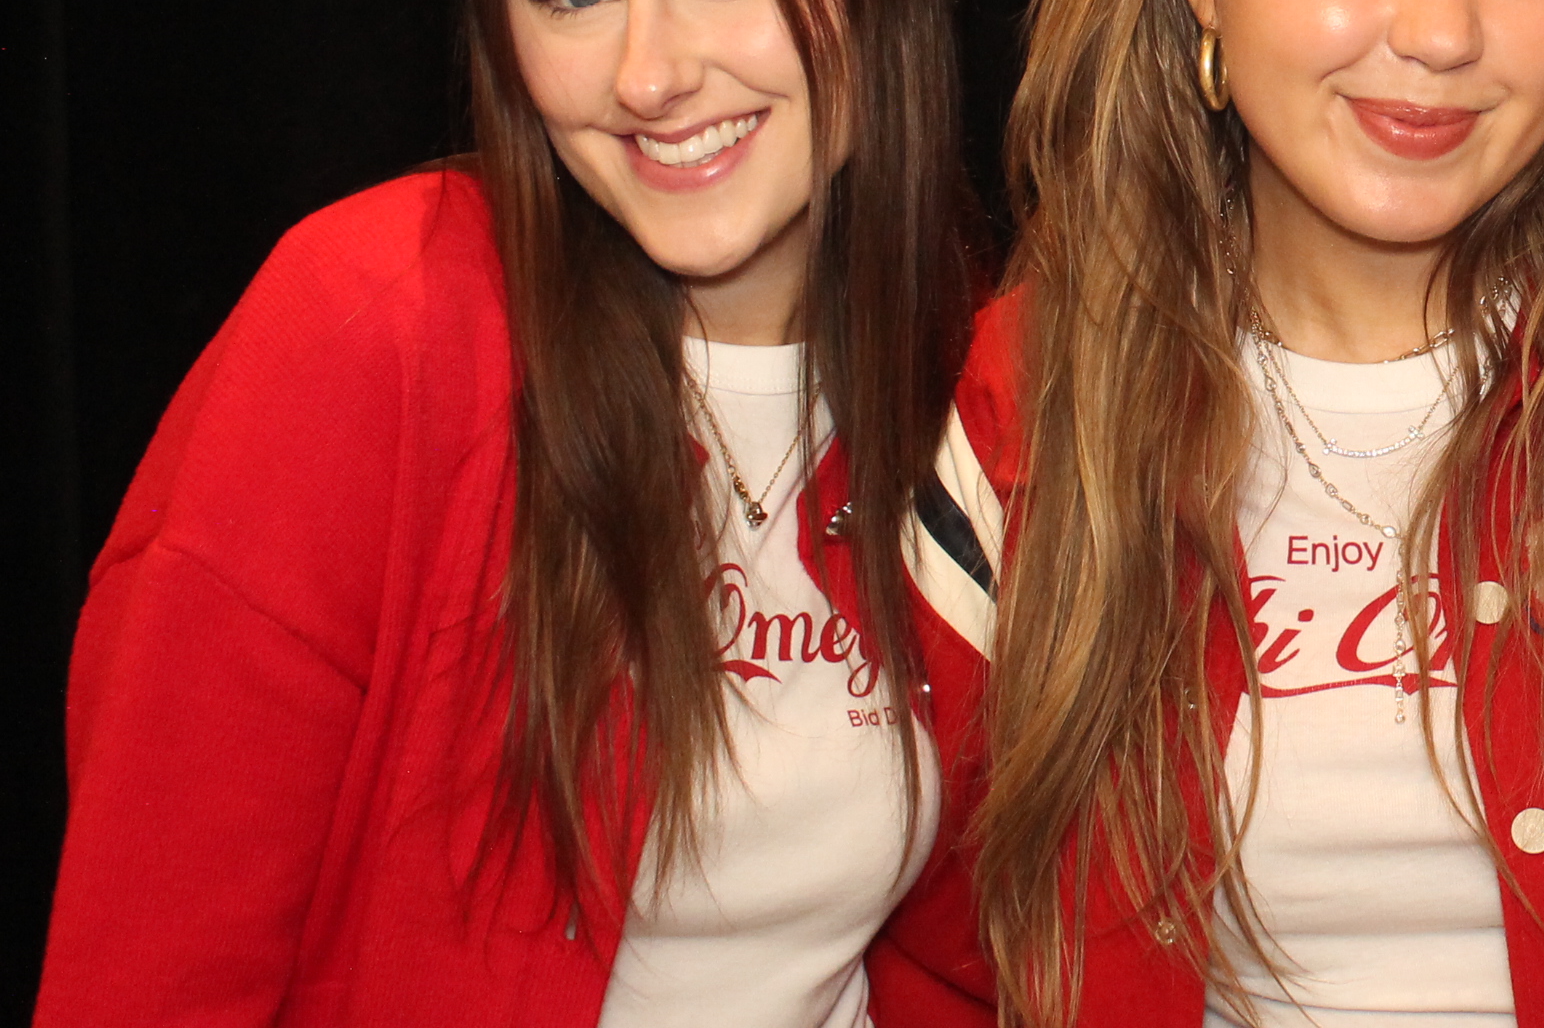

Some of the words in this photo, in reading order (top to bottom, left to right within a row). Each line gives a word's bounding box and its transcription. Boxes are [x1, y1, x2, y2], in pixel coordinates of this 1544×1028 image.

[1287, 535, 1384, 572] Enjoy
[703, 563, 886, 698] Omeg
[847, 708, 880, 727] Bid
